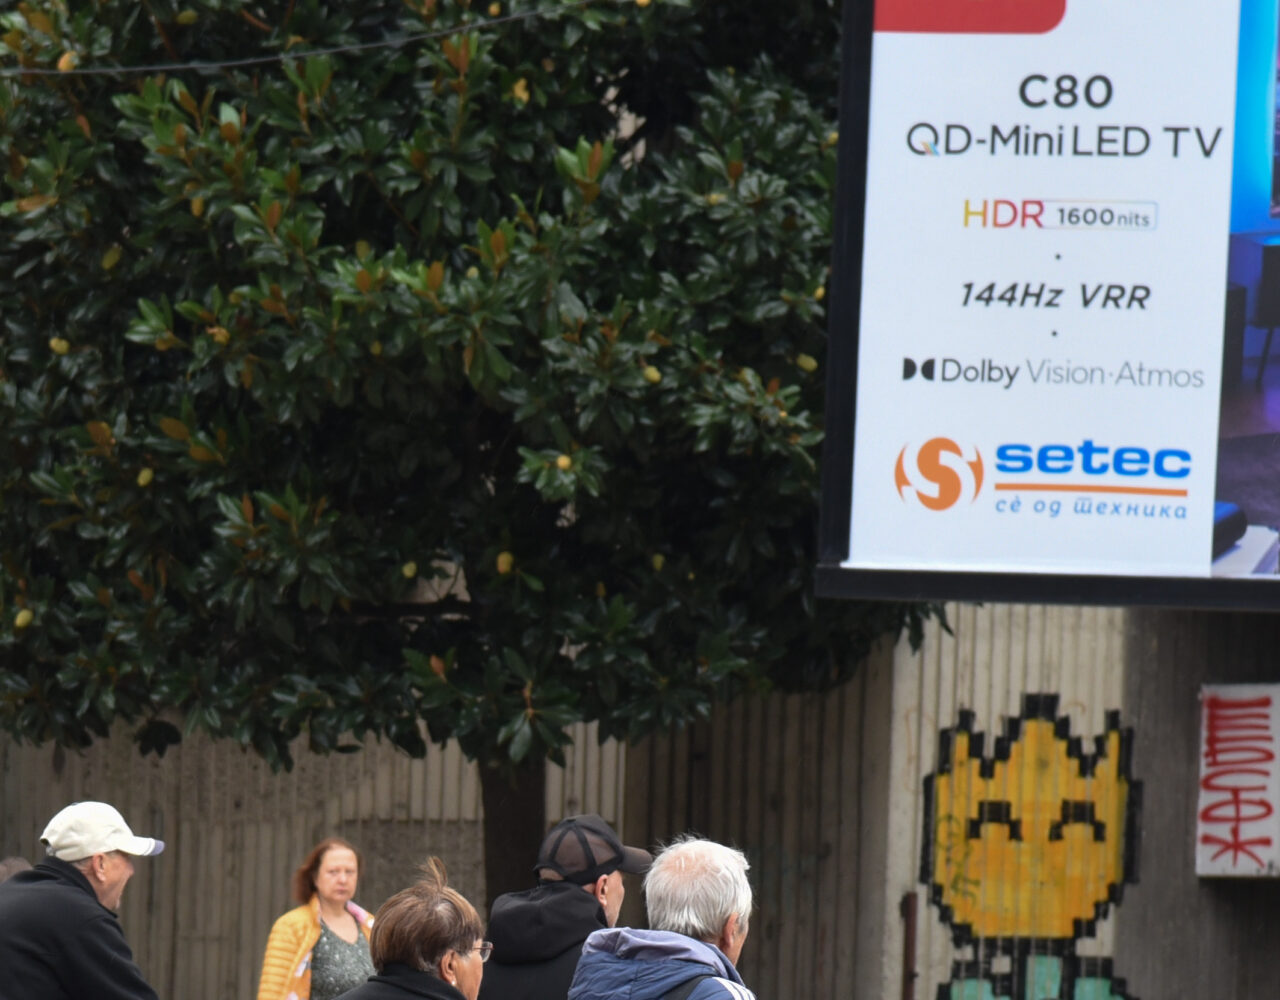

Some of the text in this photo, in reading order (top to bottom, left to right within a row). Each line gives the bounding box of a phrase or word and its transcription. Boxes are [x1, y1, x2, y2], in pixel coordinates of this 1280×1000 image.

[1020, 74, 1113, 109] C80
[1163, 126, 1223, 158] TV
[964, 199, 1045, 229] HDR
[961, 282, 1151, 310] 144Hz VRR
[941, 358, 1019, 389] Dolby
[995, 439, 1192, 479] setec
[1033, 500, 1061, 518] од
